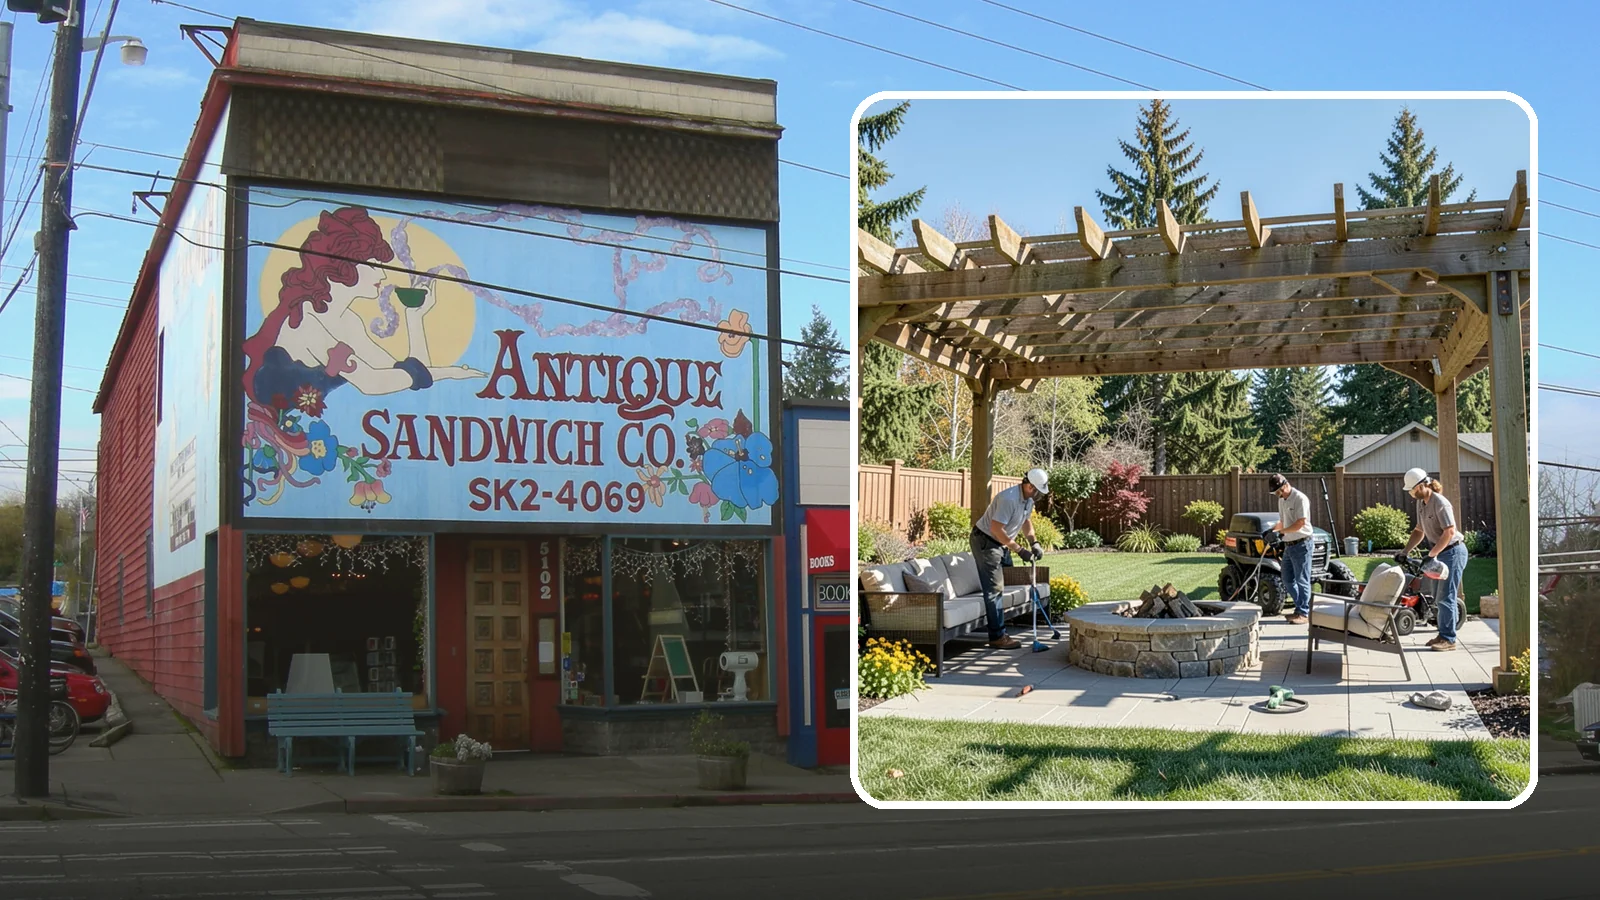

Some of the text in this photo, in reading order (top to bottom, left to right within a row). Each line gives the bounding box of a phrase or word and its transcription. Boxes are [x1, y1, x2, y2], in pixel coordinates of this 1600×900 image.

[476, 329, 723, 420] ANTIQUE
[361, 409, 685, 468] SANDWICH CO.
[469, 477, 645, 513] SK2-4069
[540, 541, 551, 599] 5102
[809, 555, 834, 568] BOOKS
